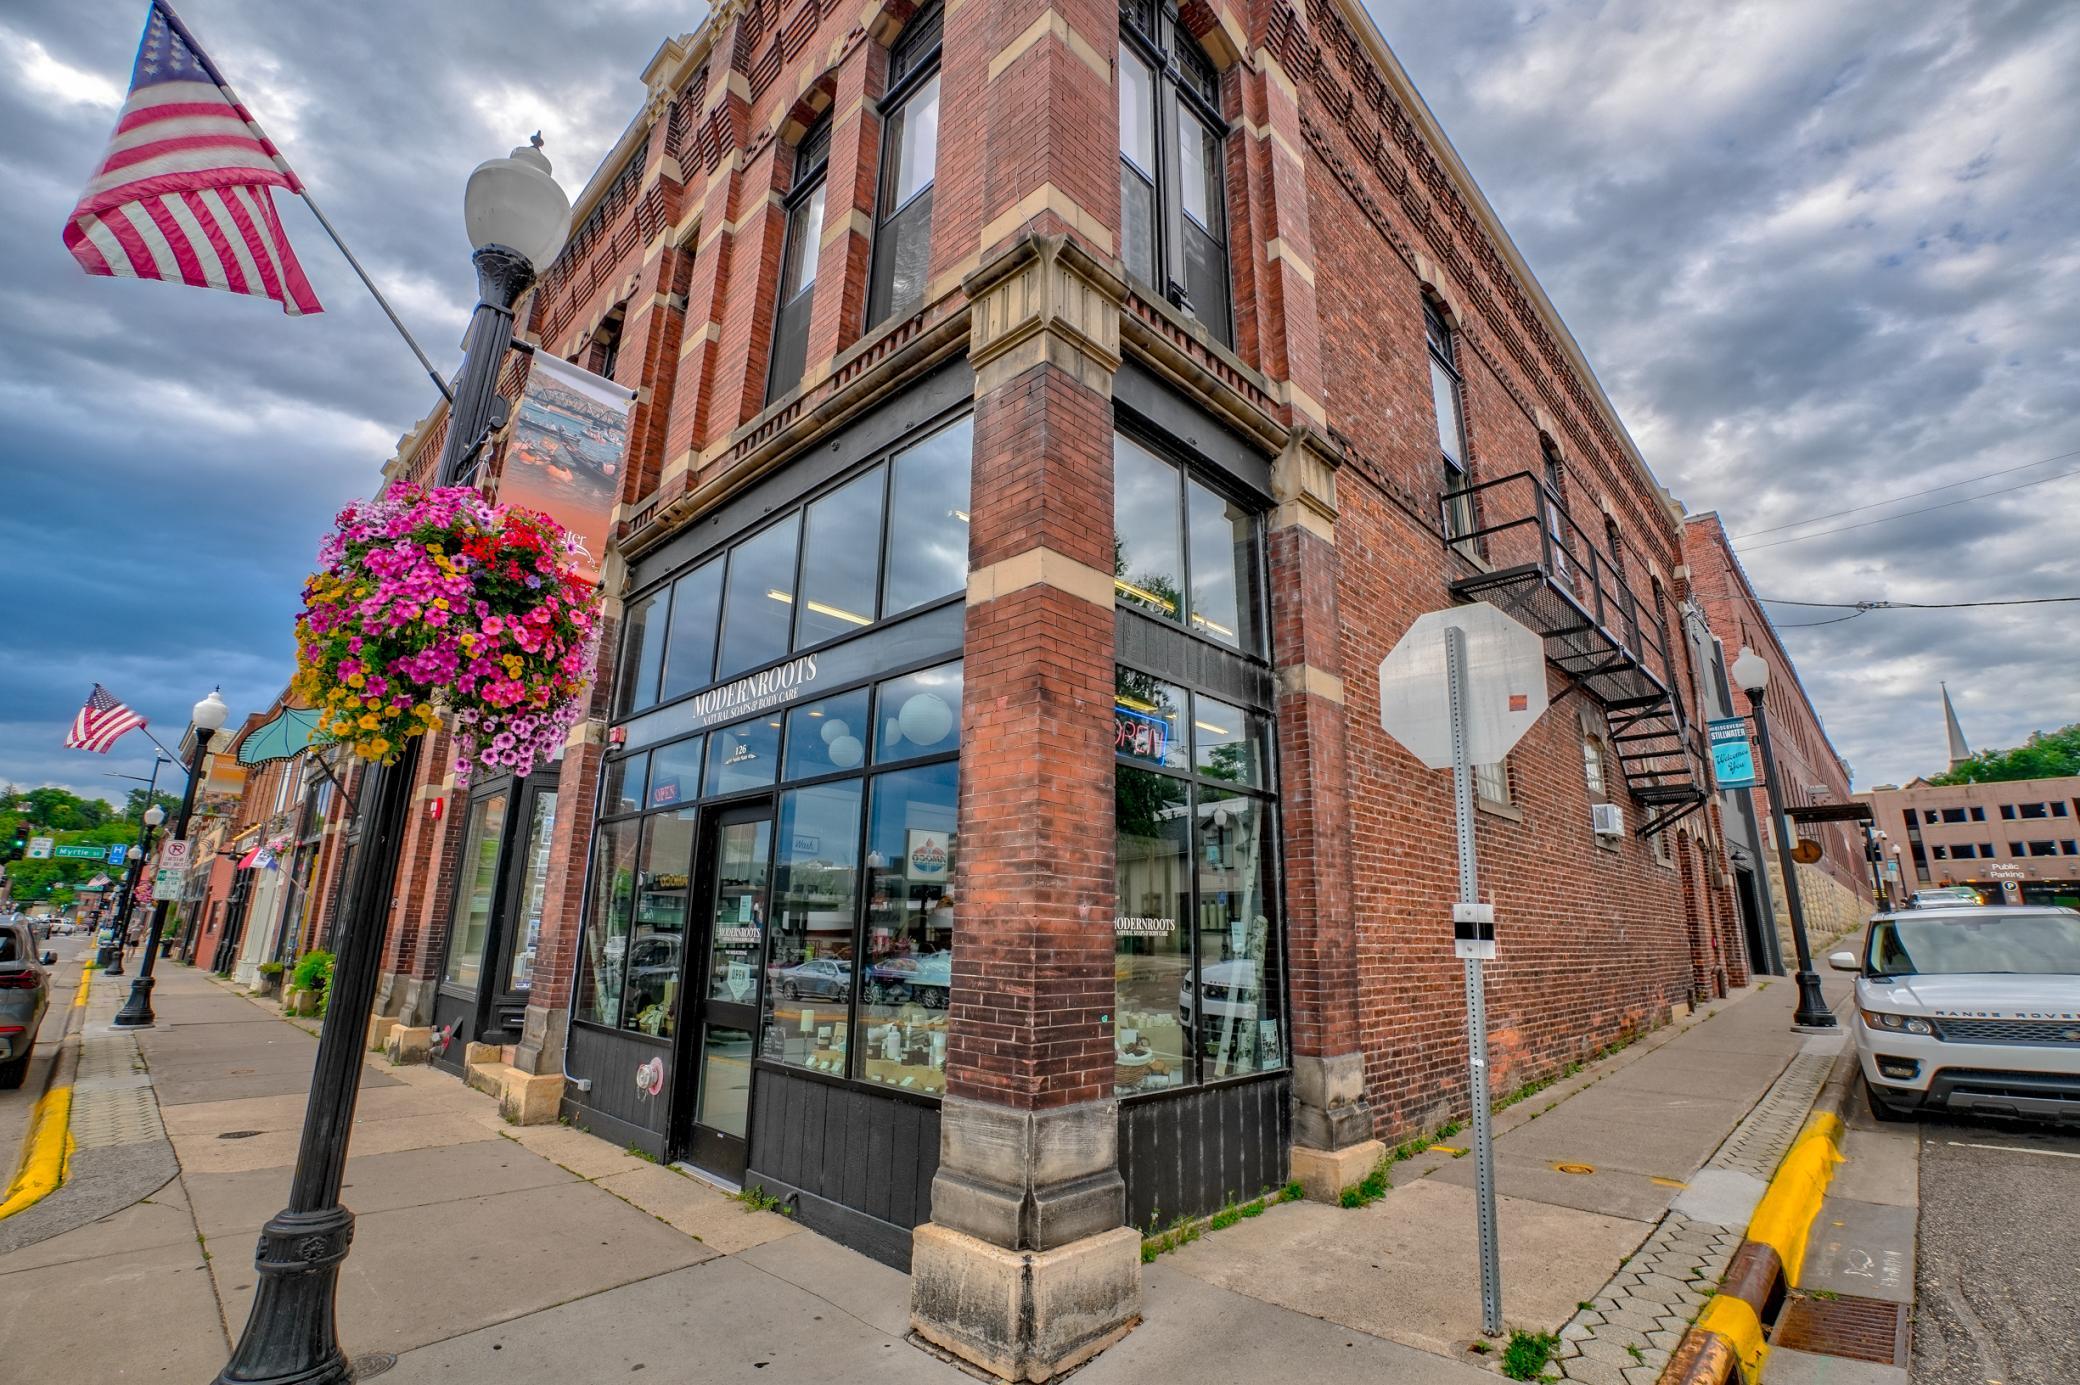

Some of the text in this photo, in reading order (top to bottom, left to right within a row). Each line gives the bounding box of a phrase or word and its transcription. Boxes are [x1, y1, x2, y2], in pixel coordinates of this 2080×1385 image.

[692, 652, 817, 719] MODERNROOTS
[703, 708, 730, 726] NATURAL
[730, 702, 751, 719] SOAPS
[759, 694, 779, 709] BODY
[779, 687, 799, 703] CARE
[1711, 728, 1745, 740] STILLWATER
[735, 744, 747, 755] 126
[59, 848, 89, 856] Myrtle
[1990, 871, 2025, 879] Parking
[1935, 1010, 2001, 1018] RANGE
